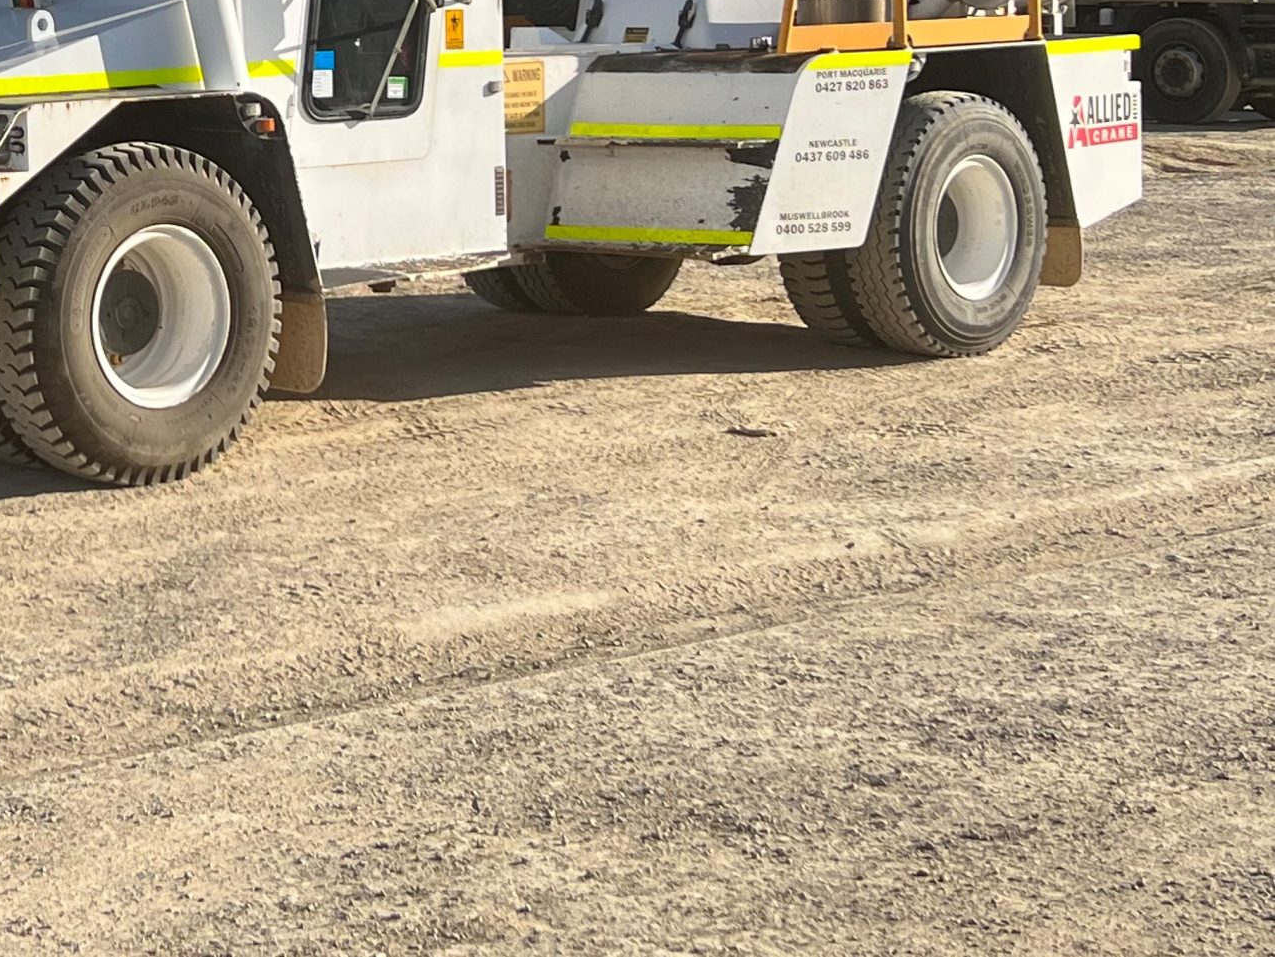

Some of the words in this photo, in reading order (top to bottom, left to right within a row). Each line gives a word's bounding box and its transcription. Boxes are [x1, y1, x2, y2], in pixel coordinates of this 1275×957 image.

[816, 71, 838, 79] PORT
[840, 68, 887, 78] MACQUARIE
[815, 82, 843, 93] 0427
[845, 80, 866, 91] 820
[868, 79, 889, 90] 863
[1087, 92, 1131, 124] ALLIED
[1092, 126, 1133, 143] CRANE
[808, 139, 857, 148] NEWCASTLE
[795, 152, 822, 162] 0437
[826, 151, 846, 161] 609
[849, 149, 870, 159] 486
[779, 210, 849, 221] MUSWELLBROOK
[776, 224, 805, 235] 0400
[808, 223, 828, 233] 528
[831, 221, 851, 232] 599
